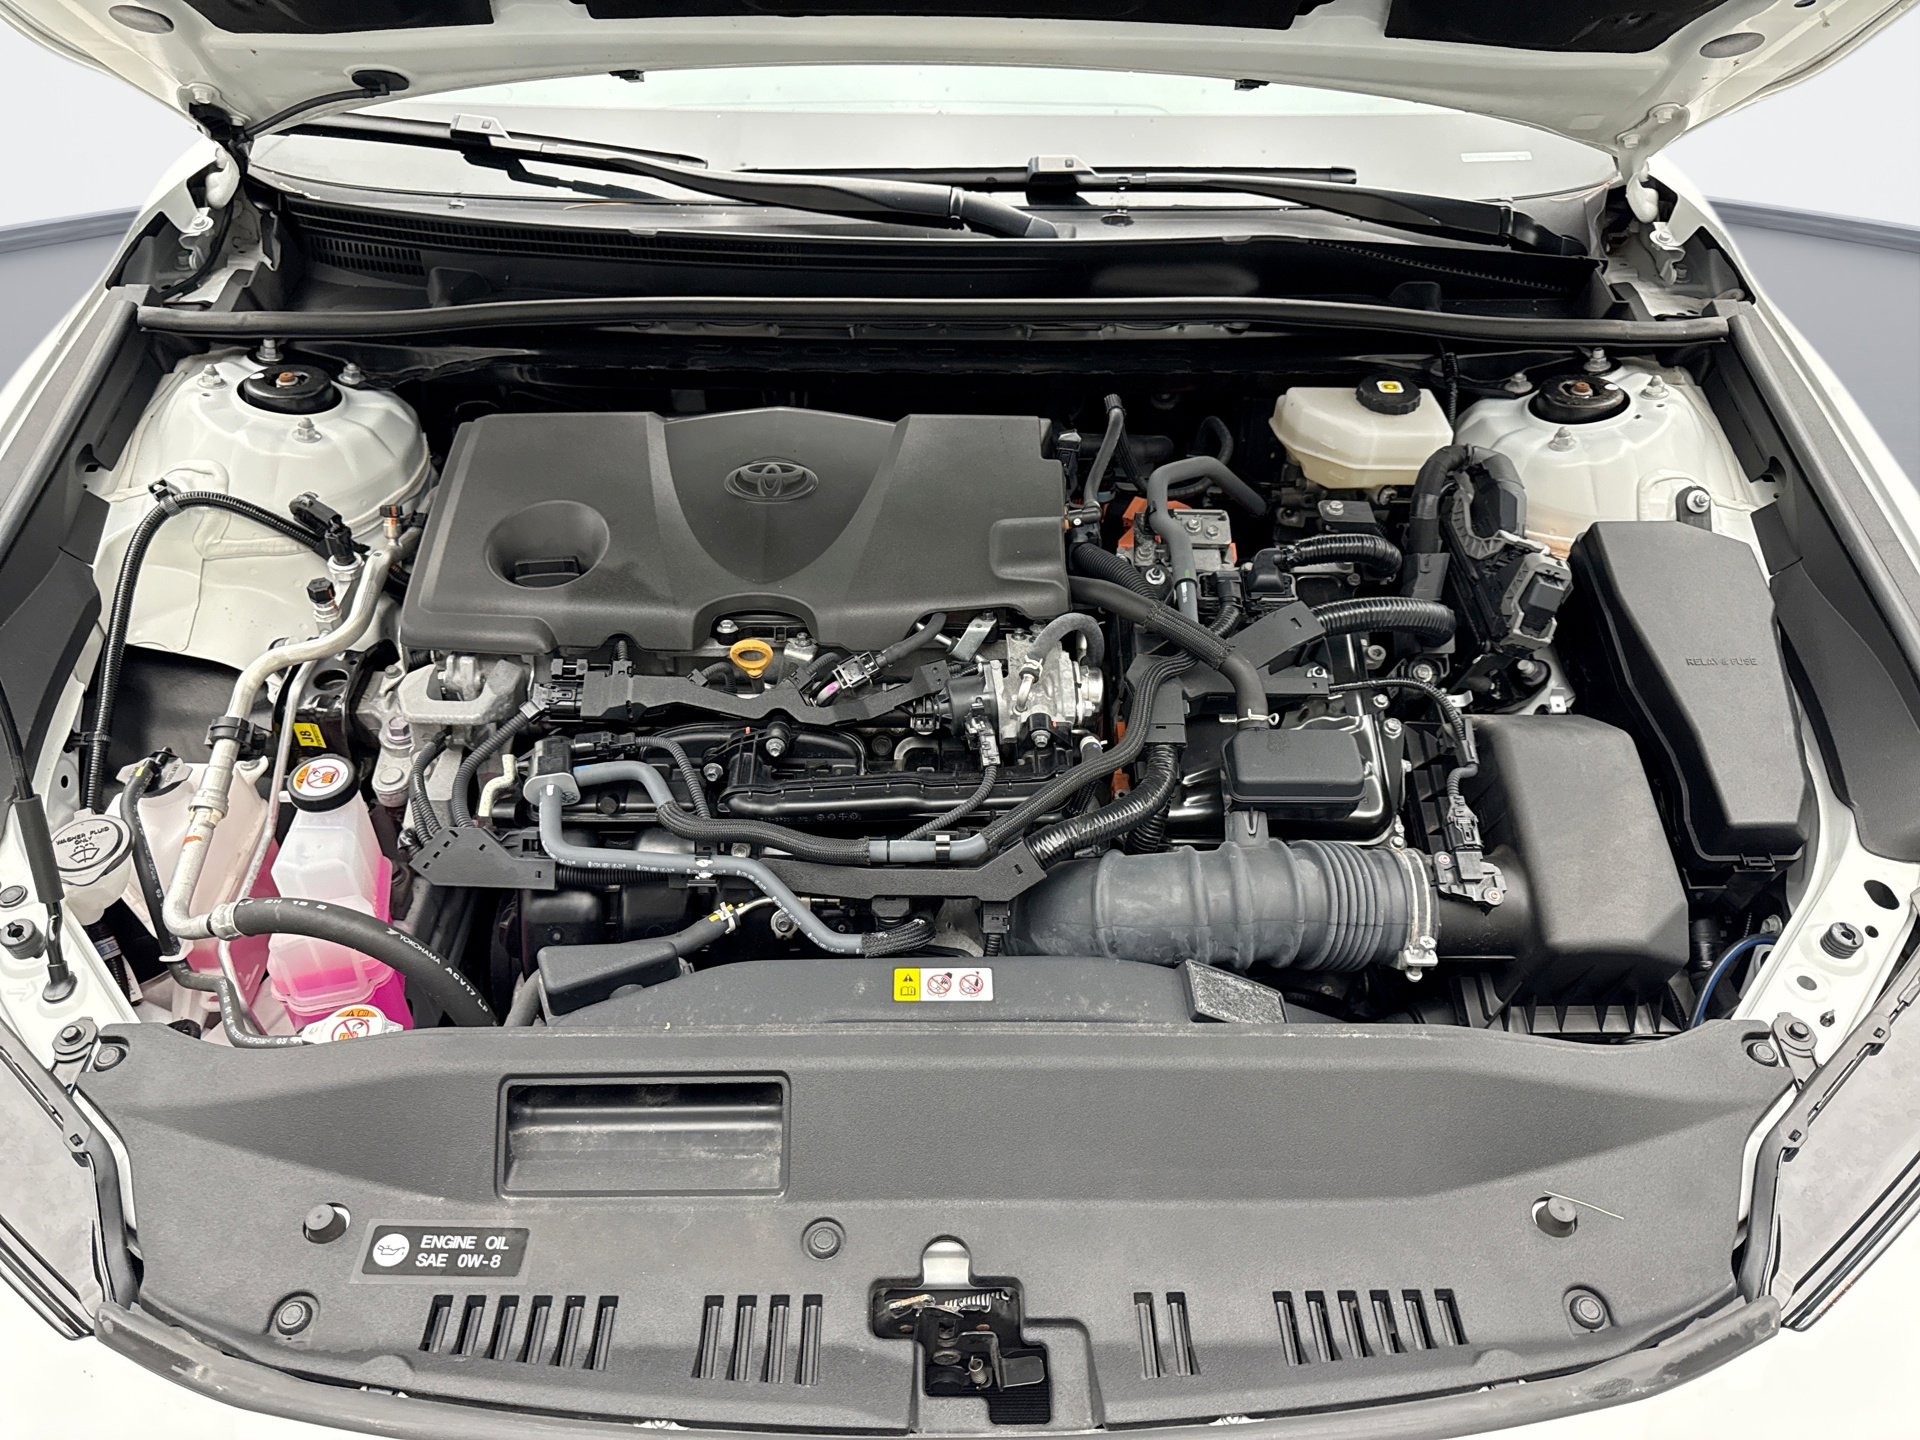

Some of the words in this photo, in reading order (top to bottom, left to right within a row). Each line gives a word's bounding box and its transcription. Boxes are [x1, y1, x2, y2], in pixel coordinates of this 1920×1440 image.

[1730, 657, 1758, 666] FUSE
[299, 730, 314, 743] J8
[399, 933, 441, 965] YOKOHAMA
[444, 966, 477, 996] ACV17
[420, 1235, 477, 1250] ENGINE
[485, 1235, 510, 1251] OIL
[415, 1253, 448, 1267] SAE
[457, 1253, 502, 1268] 0W-8
